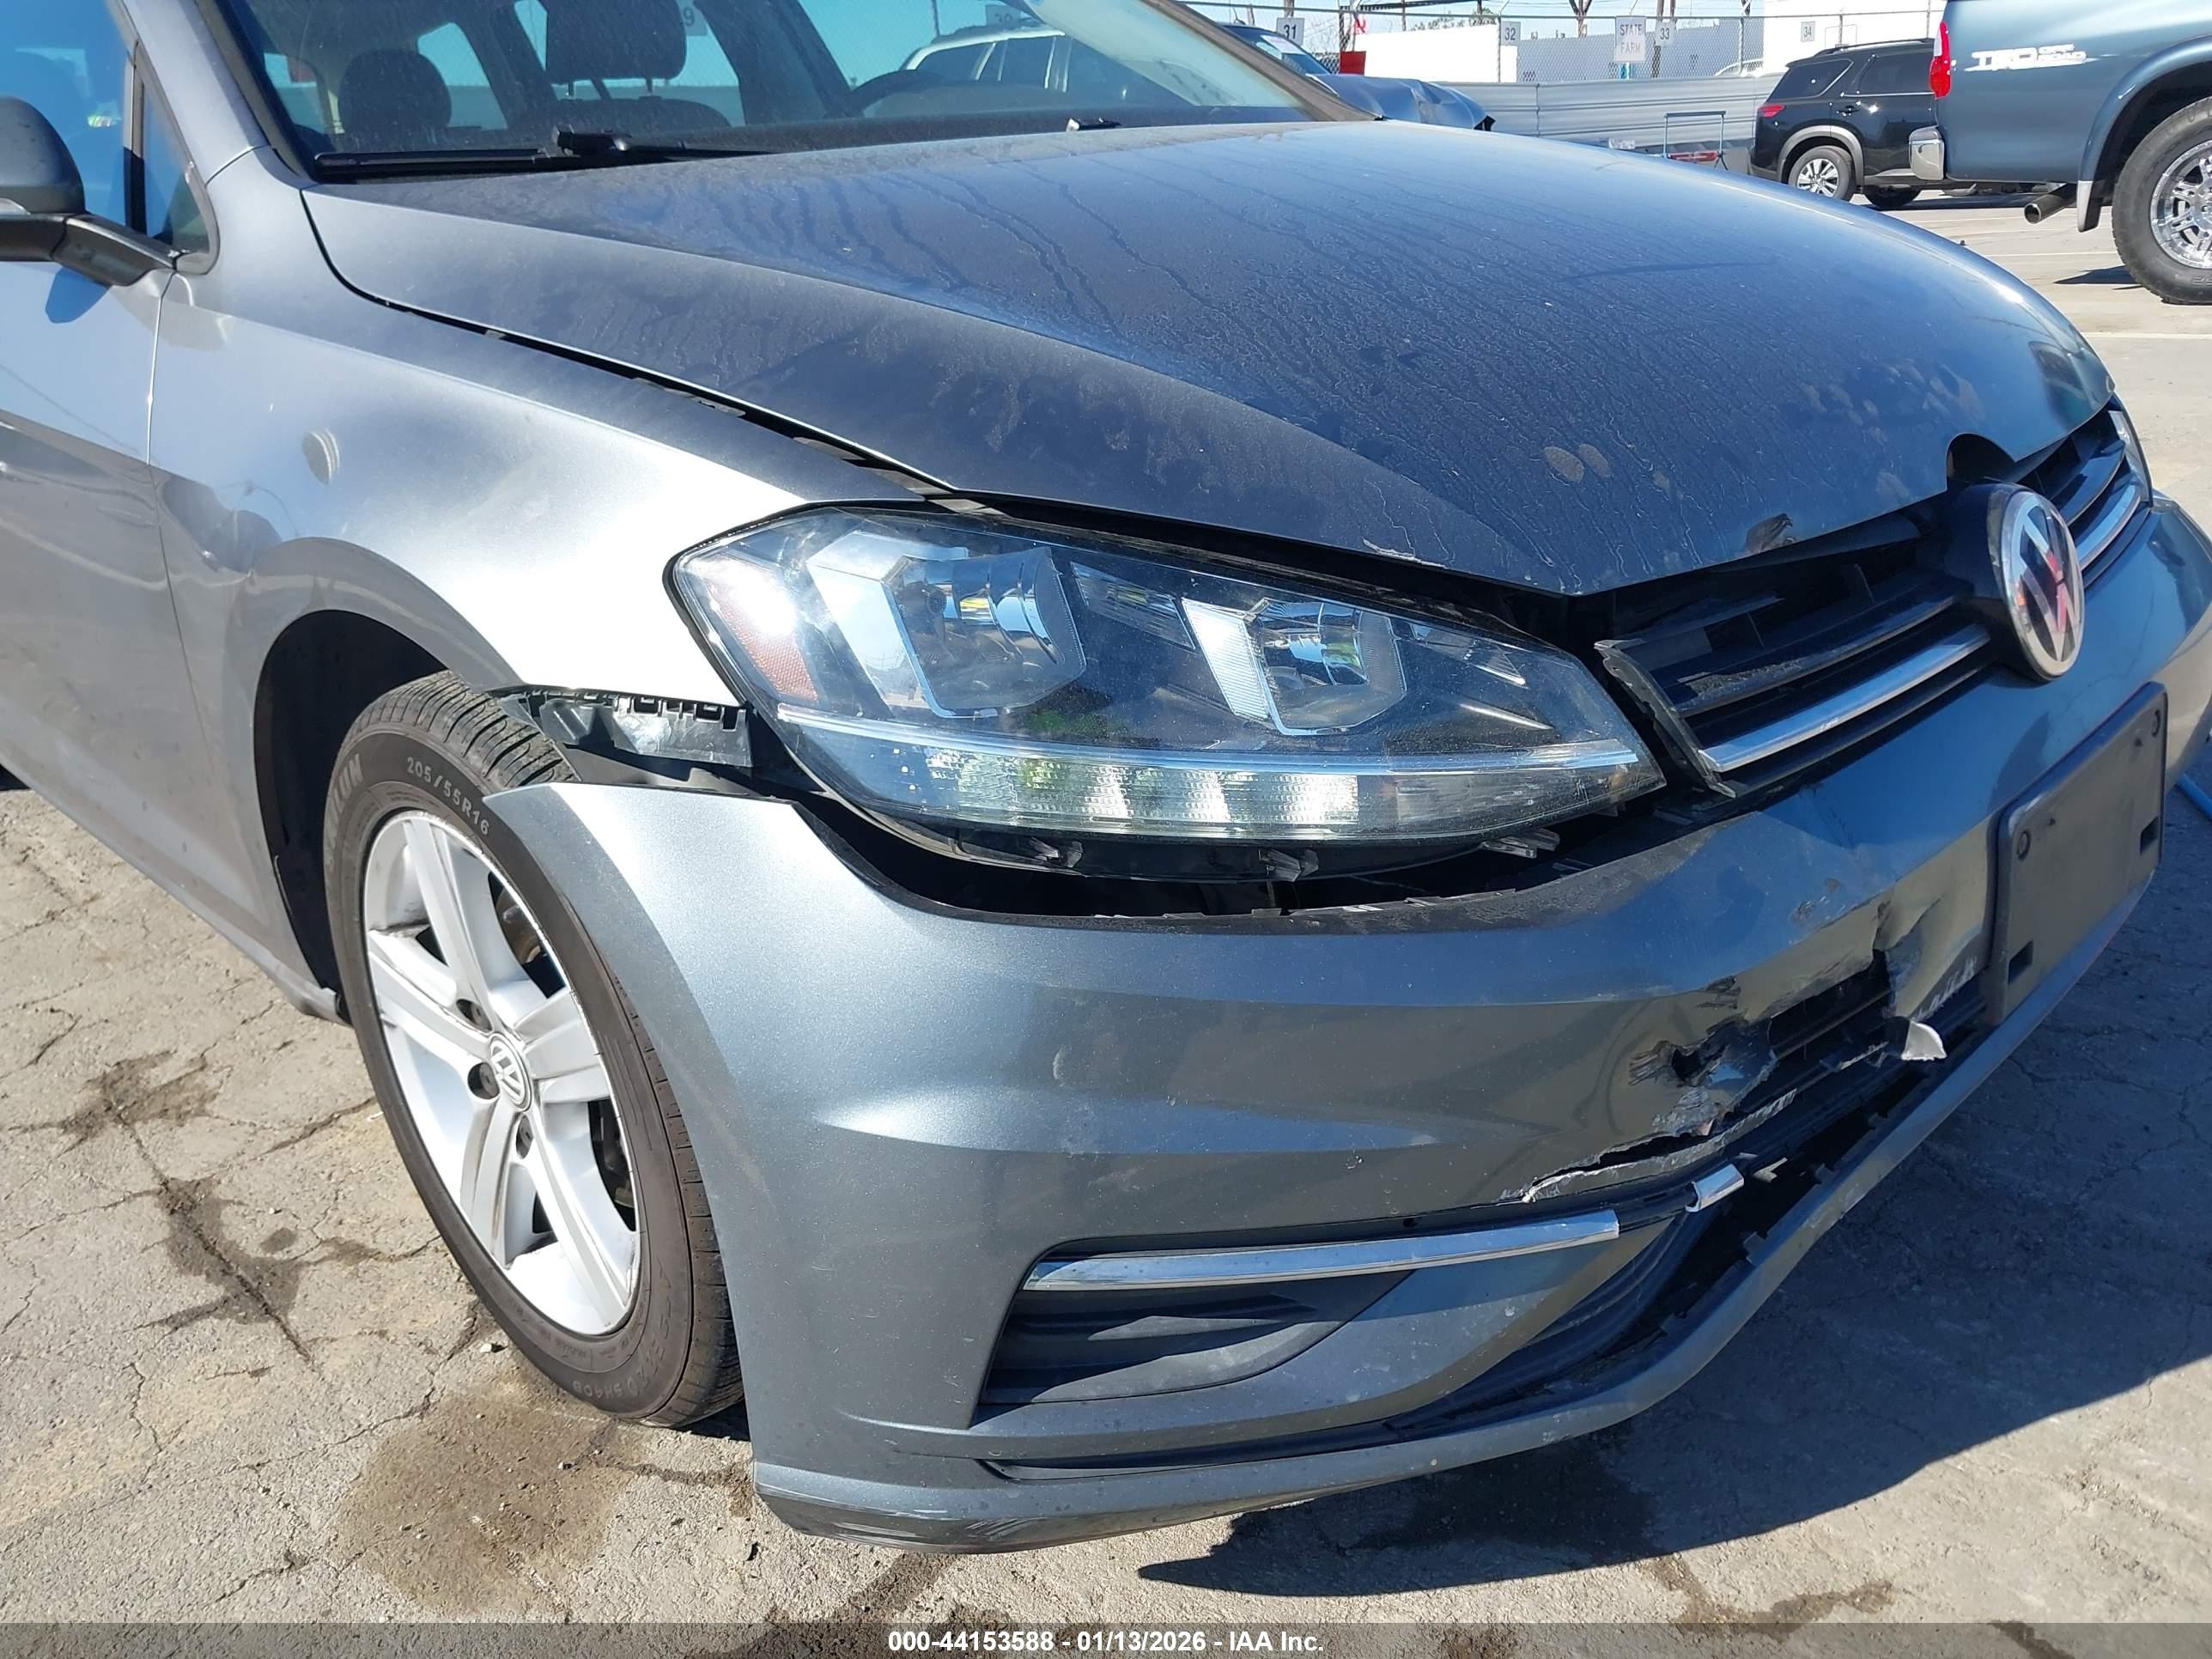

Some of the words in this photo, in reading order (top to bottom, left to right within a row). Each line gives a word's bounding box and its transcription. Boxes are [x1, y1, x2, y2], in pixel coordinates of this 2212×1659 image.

[1284, 24, 1297, 40] 31
[1504, 27, 1516, 40] 32
[1620, 23, 1643, 36] STATE
[1660, 27, 1670, 40] 33
[1803, 26, 1812, 38] 34
[1620, 42, 1641, 54] FARM
[406, 757, 490, 836] 205/55R16
